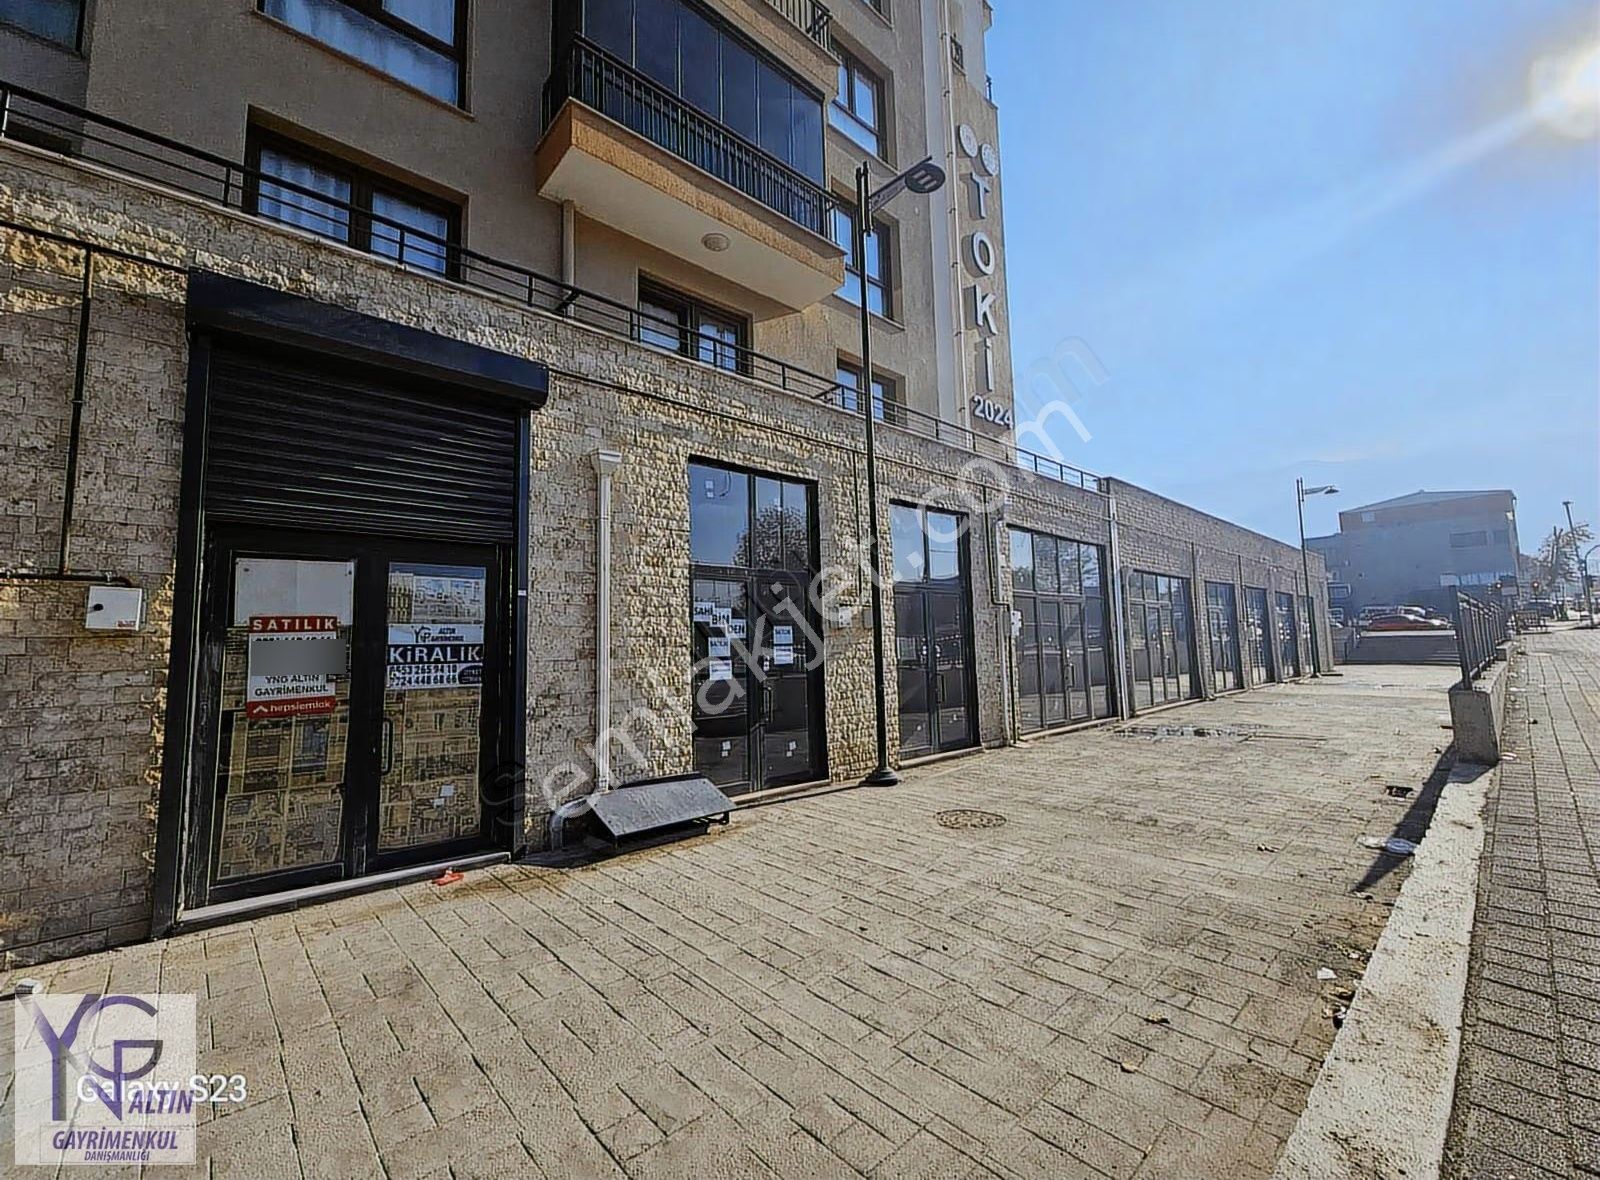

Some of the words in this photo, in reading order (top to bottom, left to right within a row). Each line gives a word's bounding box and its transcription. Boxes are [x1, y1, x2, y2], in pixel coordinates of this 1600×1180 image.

[972, 395, 1014, 429] 2024
[253, 618, 335, 630] SATILIK
[290, 674, 320, 683] ALTIN
[255, 684, 328, 696] GAYRİMENKUL
[270, 700, 331, 712] hepsiemlak
